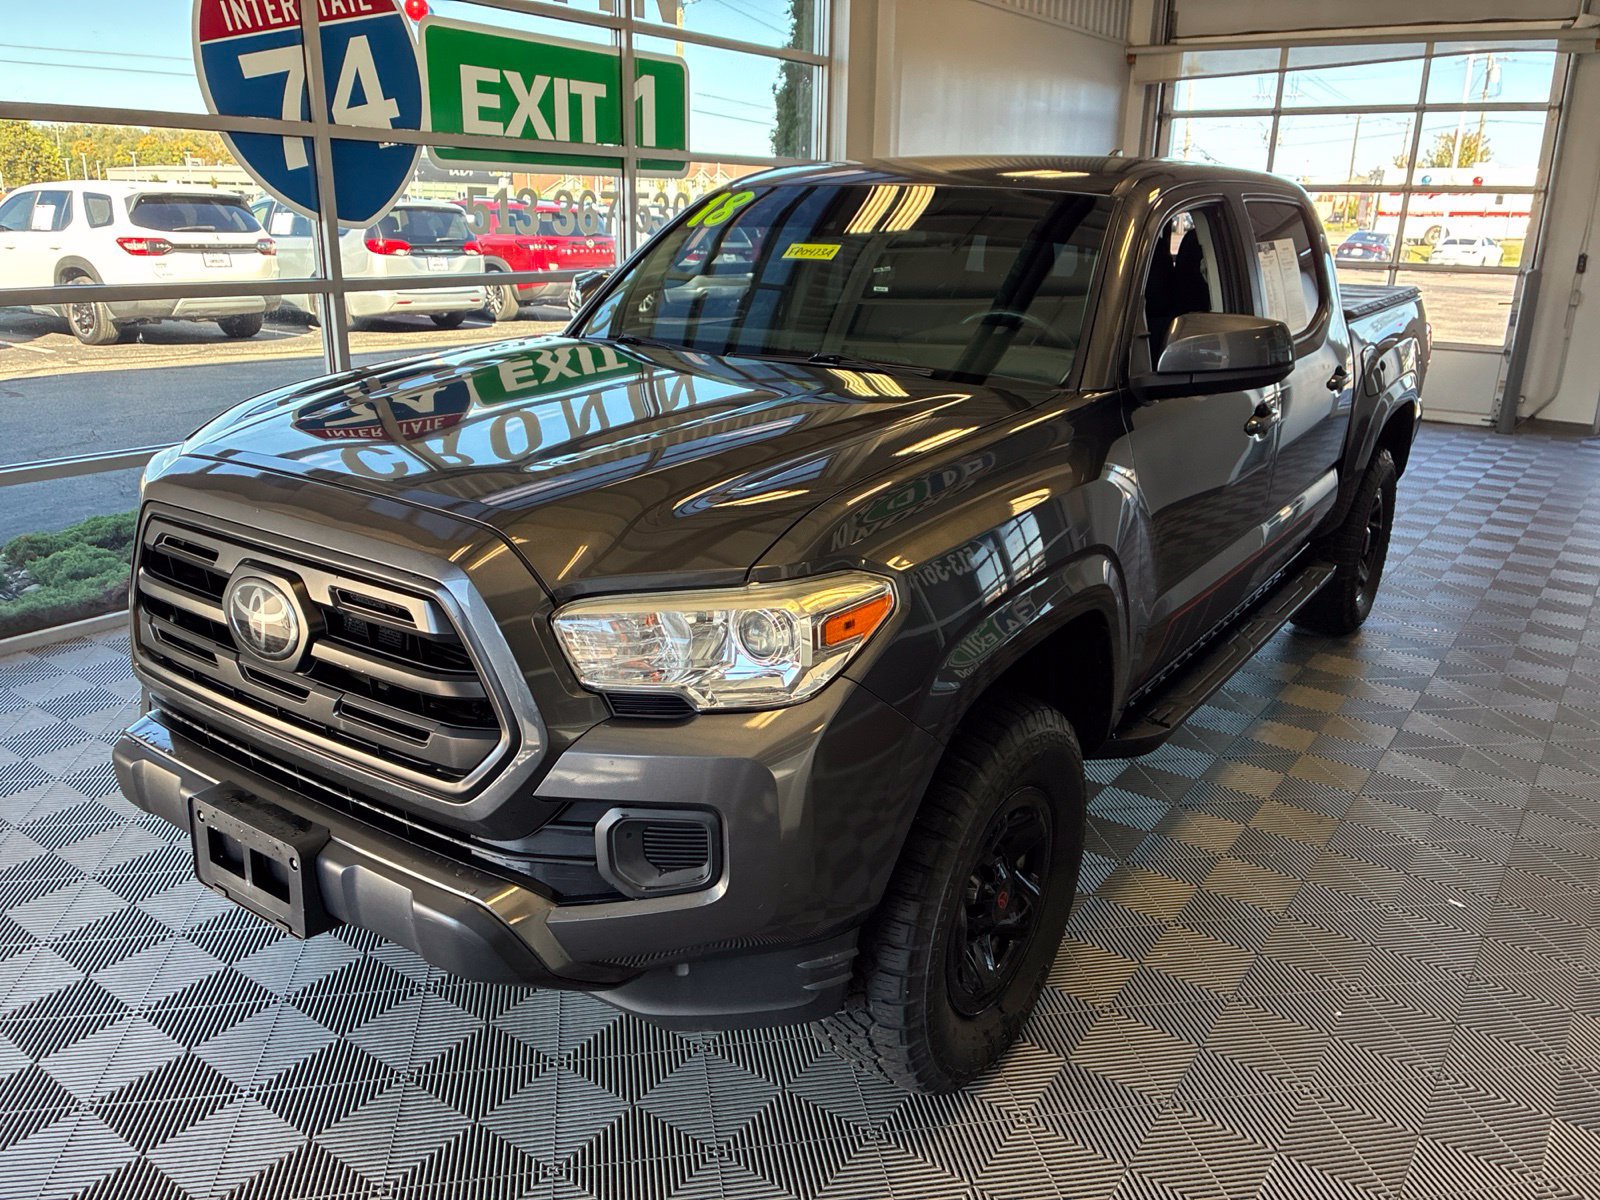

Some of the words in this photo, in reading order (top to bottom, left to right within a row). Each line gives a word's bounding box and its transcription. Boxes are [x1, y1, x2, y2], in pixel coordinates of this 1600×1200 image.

[220, 0, 373, 32] INTERTA
[238, 35, 401, 170] 74
[459, 64, 607, 144] EXIT
[633, 75, 656, 147] 1
[687, 191, 755, 227] 18
